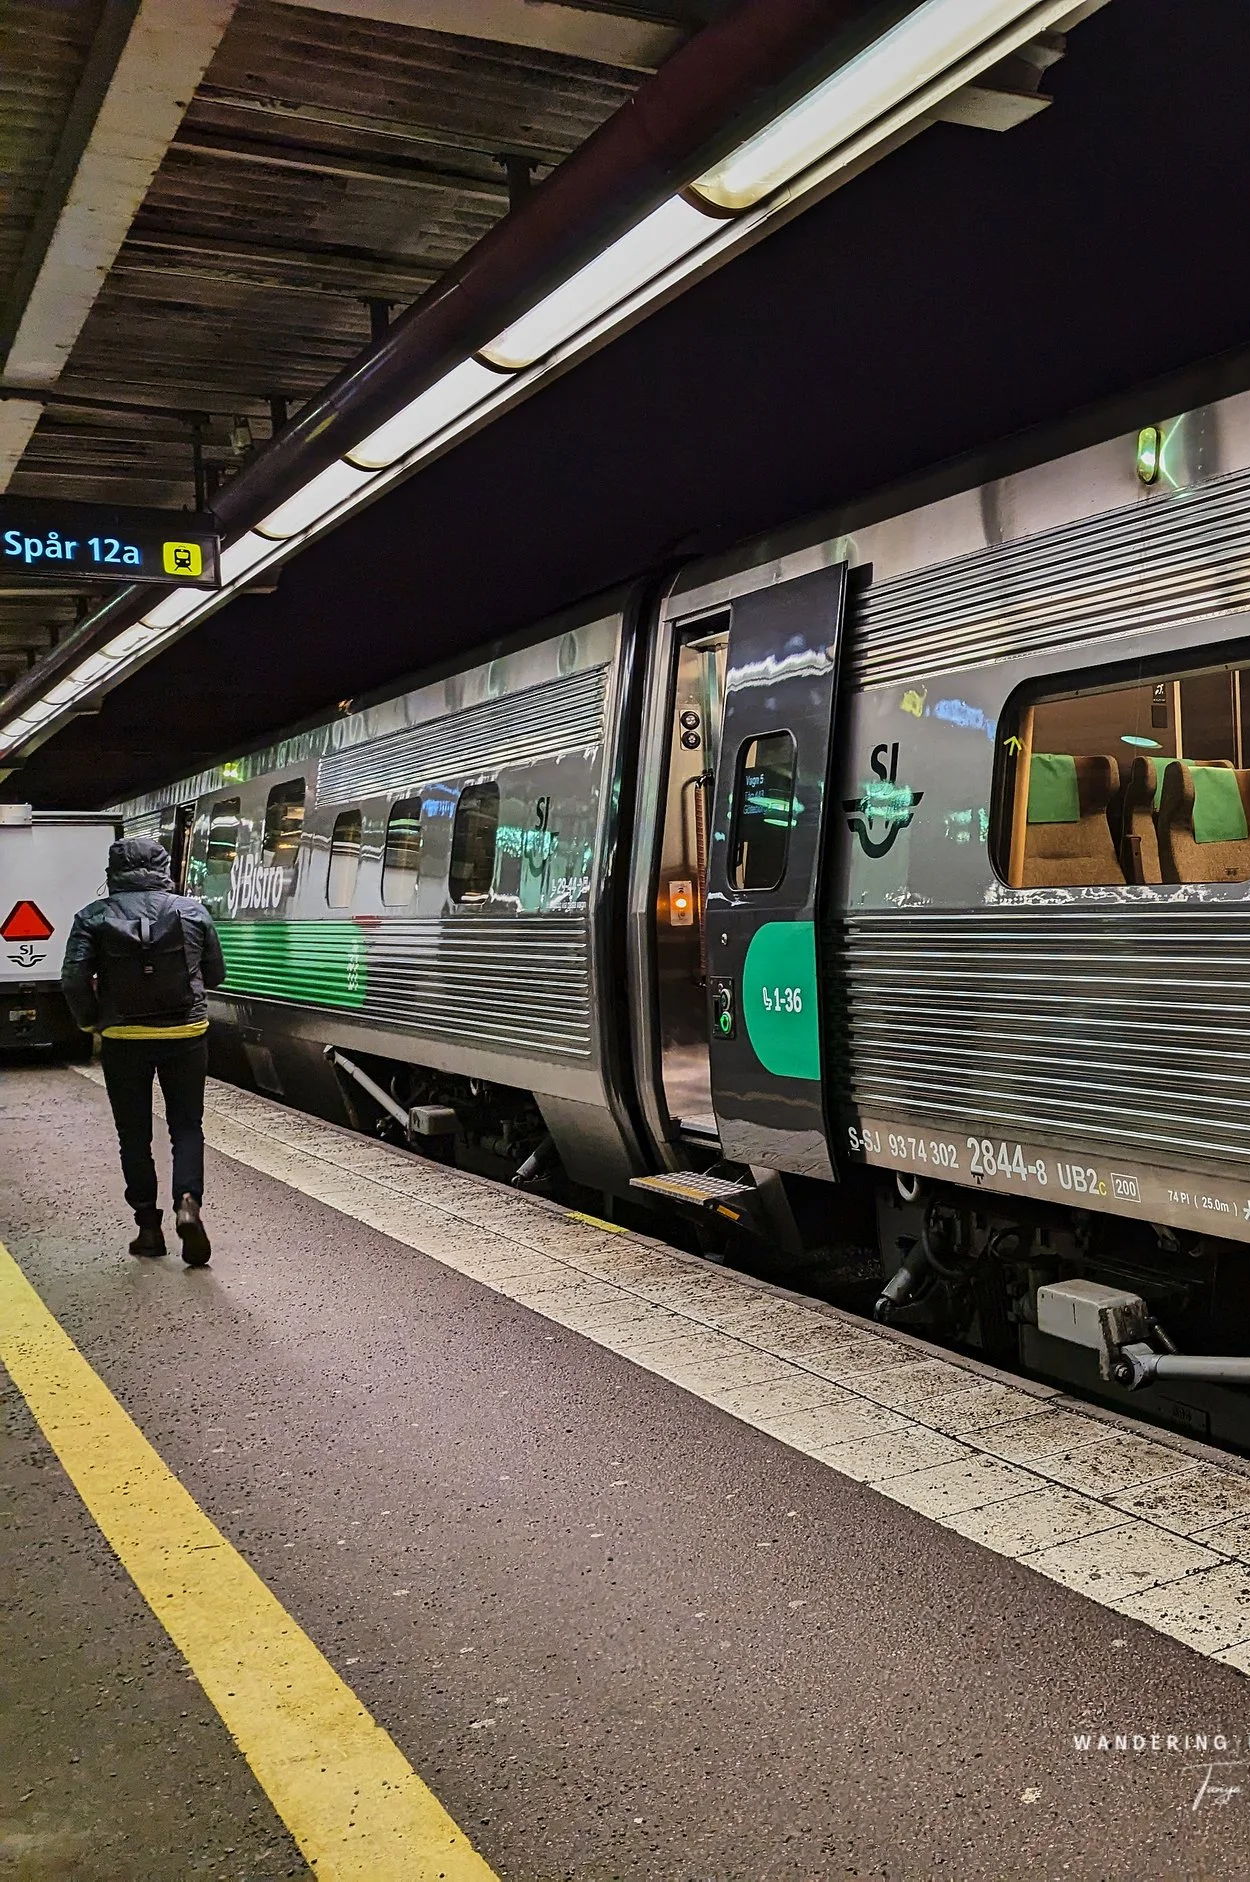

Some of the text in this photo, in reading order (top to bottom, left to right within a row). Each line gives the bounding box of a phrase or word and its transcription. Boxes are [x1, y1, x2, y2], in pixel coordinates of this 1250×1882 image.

[4, 531, 141, 565] Spår 12a
[870, 742, 900, 784] SJ
[536, 796, 551, 831] SJ
[227, 852, 284, 919] SJ Bistro
[19, 944, 34, 955] SJ
[774, 987, 802, 1013] 1-36
[848, 1126, 881, 1153] S-SJ
[929, 1141, 959, 1169] 302
[966, 1137, 1048, 1186] 2844-8
[1115, 1178, 1136, 1197] 200
